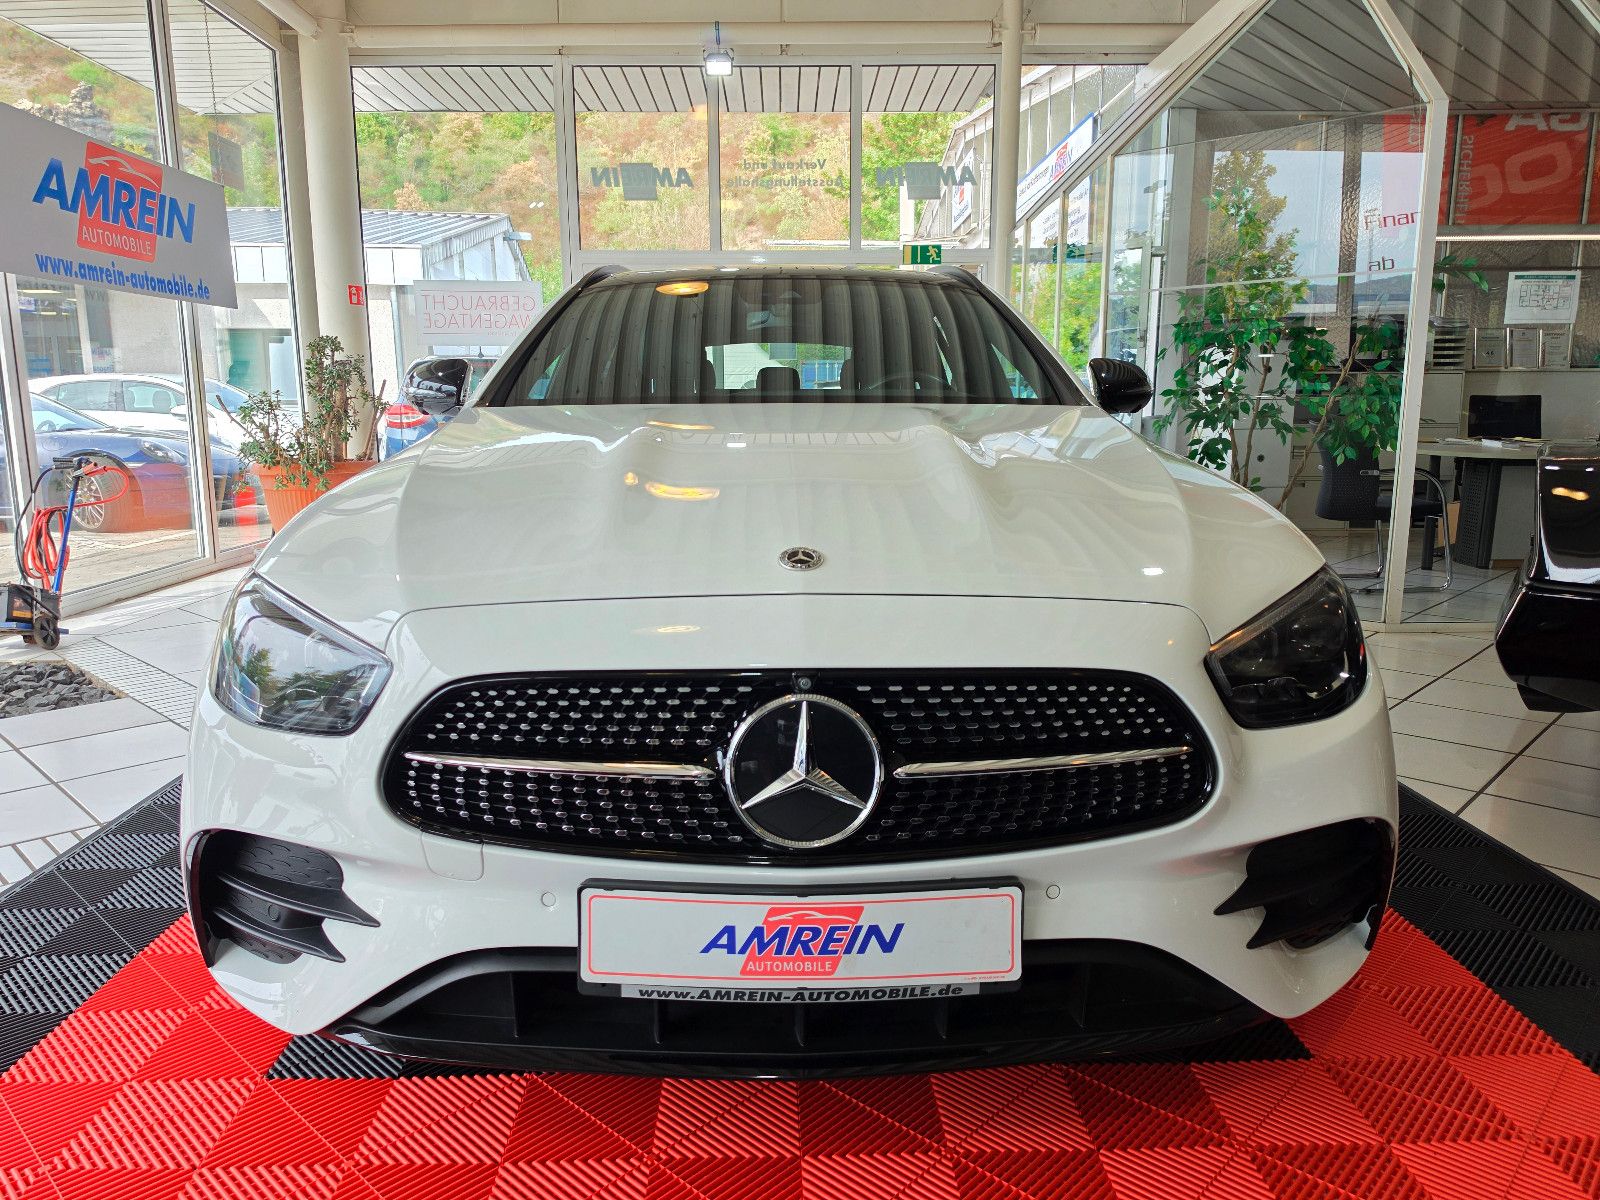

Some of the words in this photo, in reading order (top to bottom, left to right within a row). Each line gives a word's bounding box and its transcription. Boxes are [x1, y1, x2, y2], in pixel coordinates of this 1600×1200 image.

[32, 157, 196, 244] AMREIN
[82, 226, 153, 256] AUTOMOBILE
[35, 253, 210, 300] www.amrein-automobile.de
[700, 923, 905, 956] AMREIN
[747, 961, 833, 973] AUTOMOBILE
[638, 985, 964, 1002] www.AMREIN-AUTOMOBILE.de
